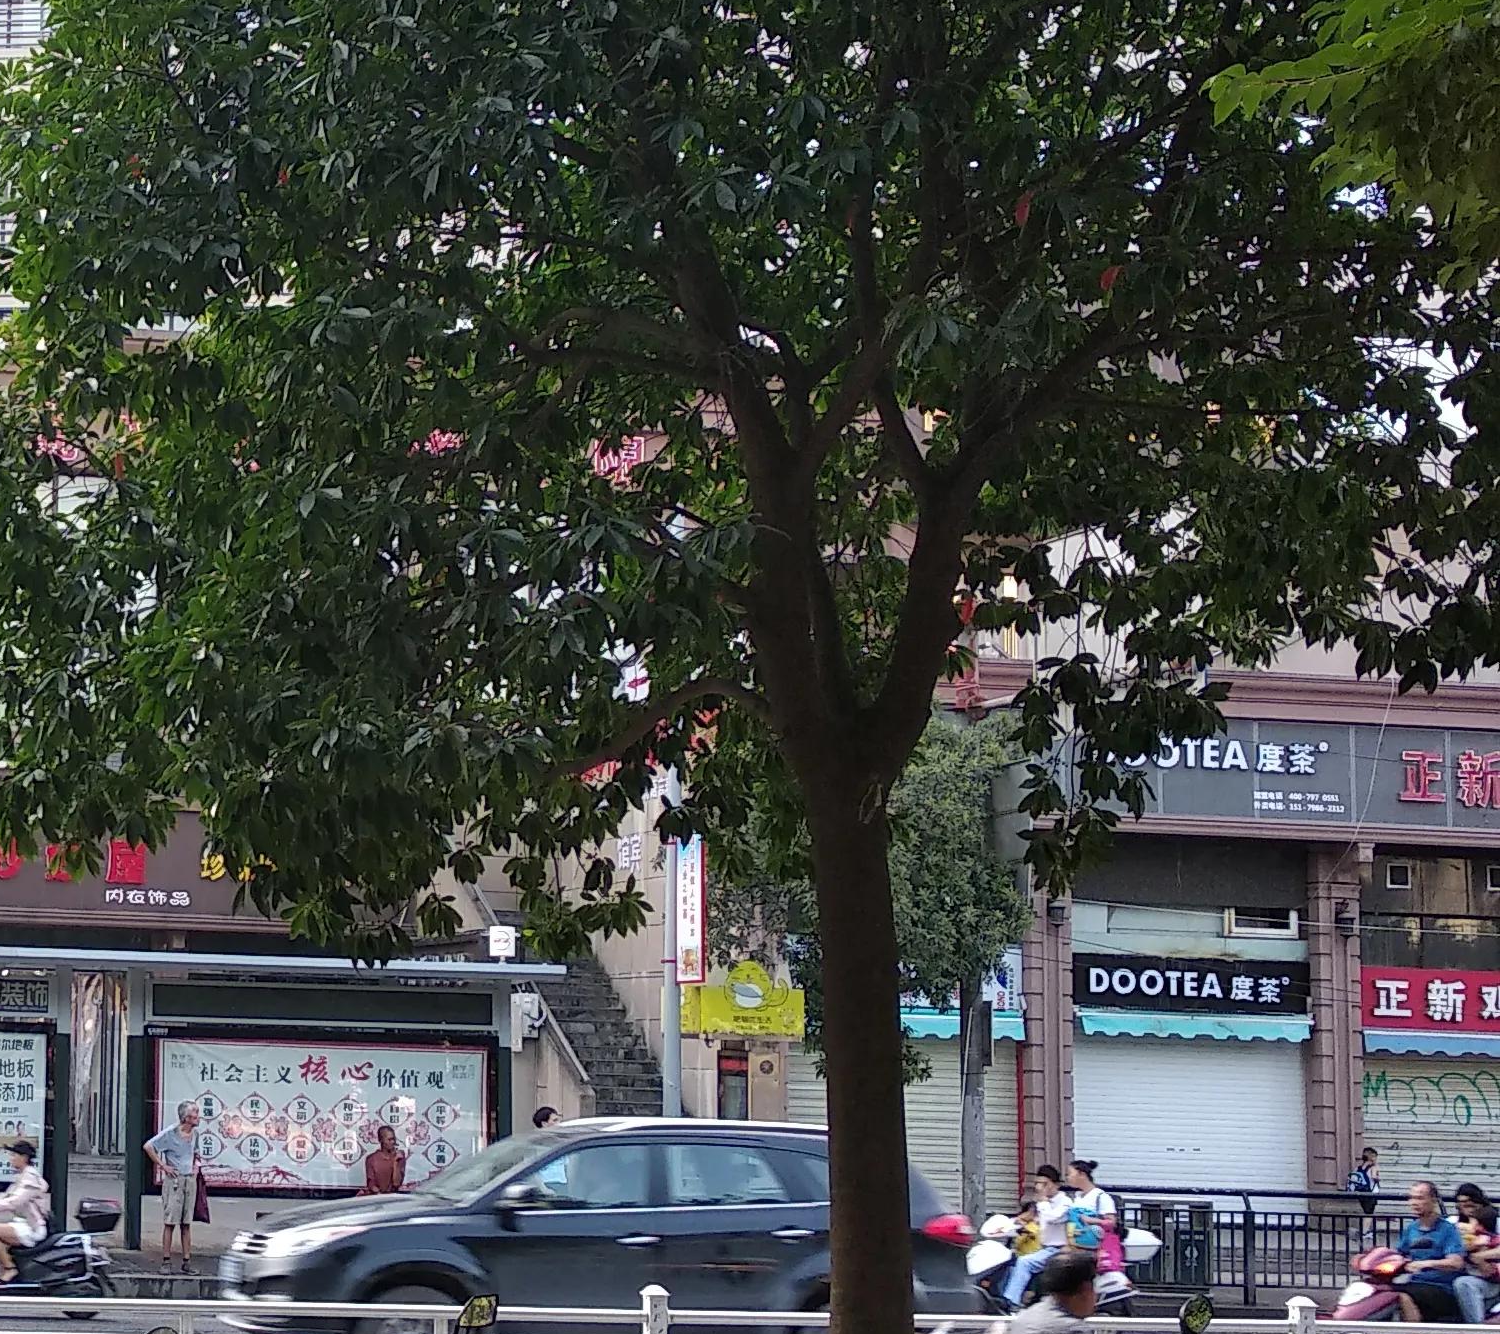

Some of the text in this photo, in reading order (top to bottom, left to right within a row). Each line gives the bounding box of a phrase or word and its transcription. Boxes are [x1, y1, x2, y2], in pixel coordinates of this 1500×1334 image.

[1256, 741, 1317, 775] 度茶
[1088, 967, 1282, 1005] DOOTEA 度茶
[200, 1055, 445, 1090] 社会主义核心价值观
